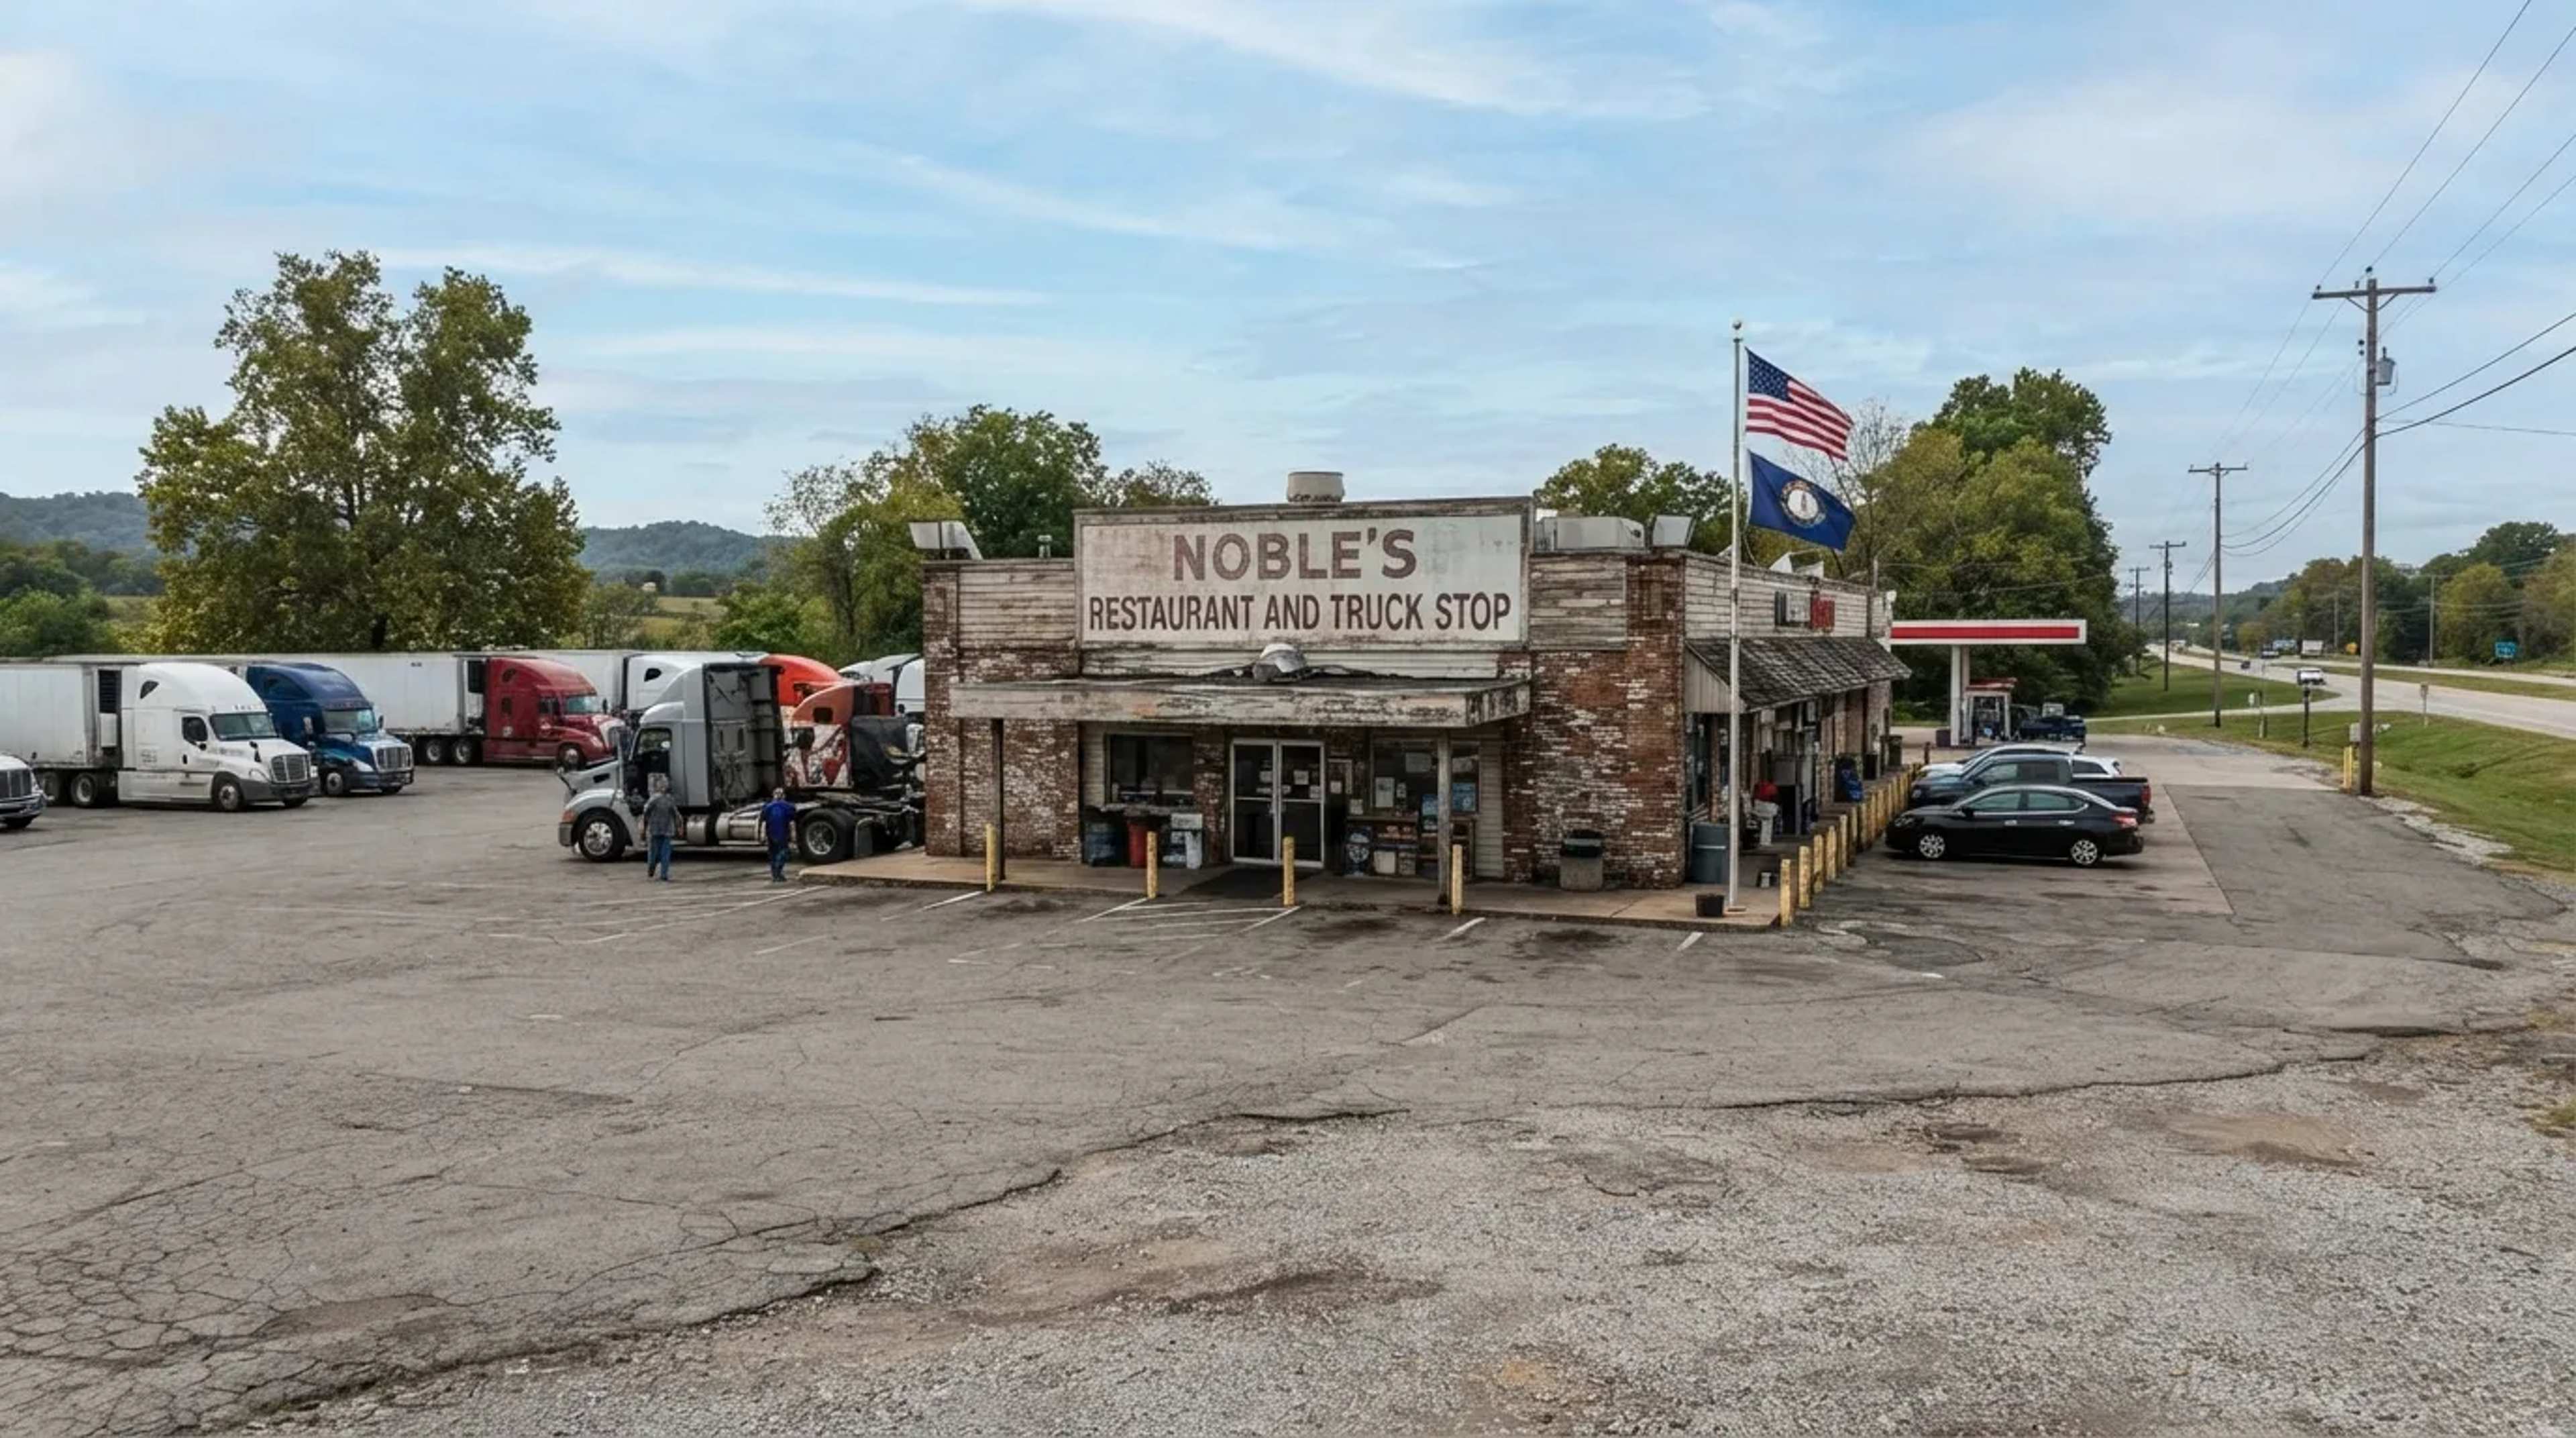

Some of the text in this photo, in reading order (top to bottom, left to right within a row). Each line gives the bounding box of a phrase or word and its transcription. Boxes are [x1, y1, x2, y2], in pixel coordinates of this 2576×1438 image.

[1173, 527, 1417, 581] NOBLE'S
[1089, 590, 1512, 631] RESTAURANT AND TRUCK STOP
